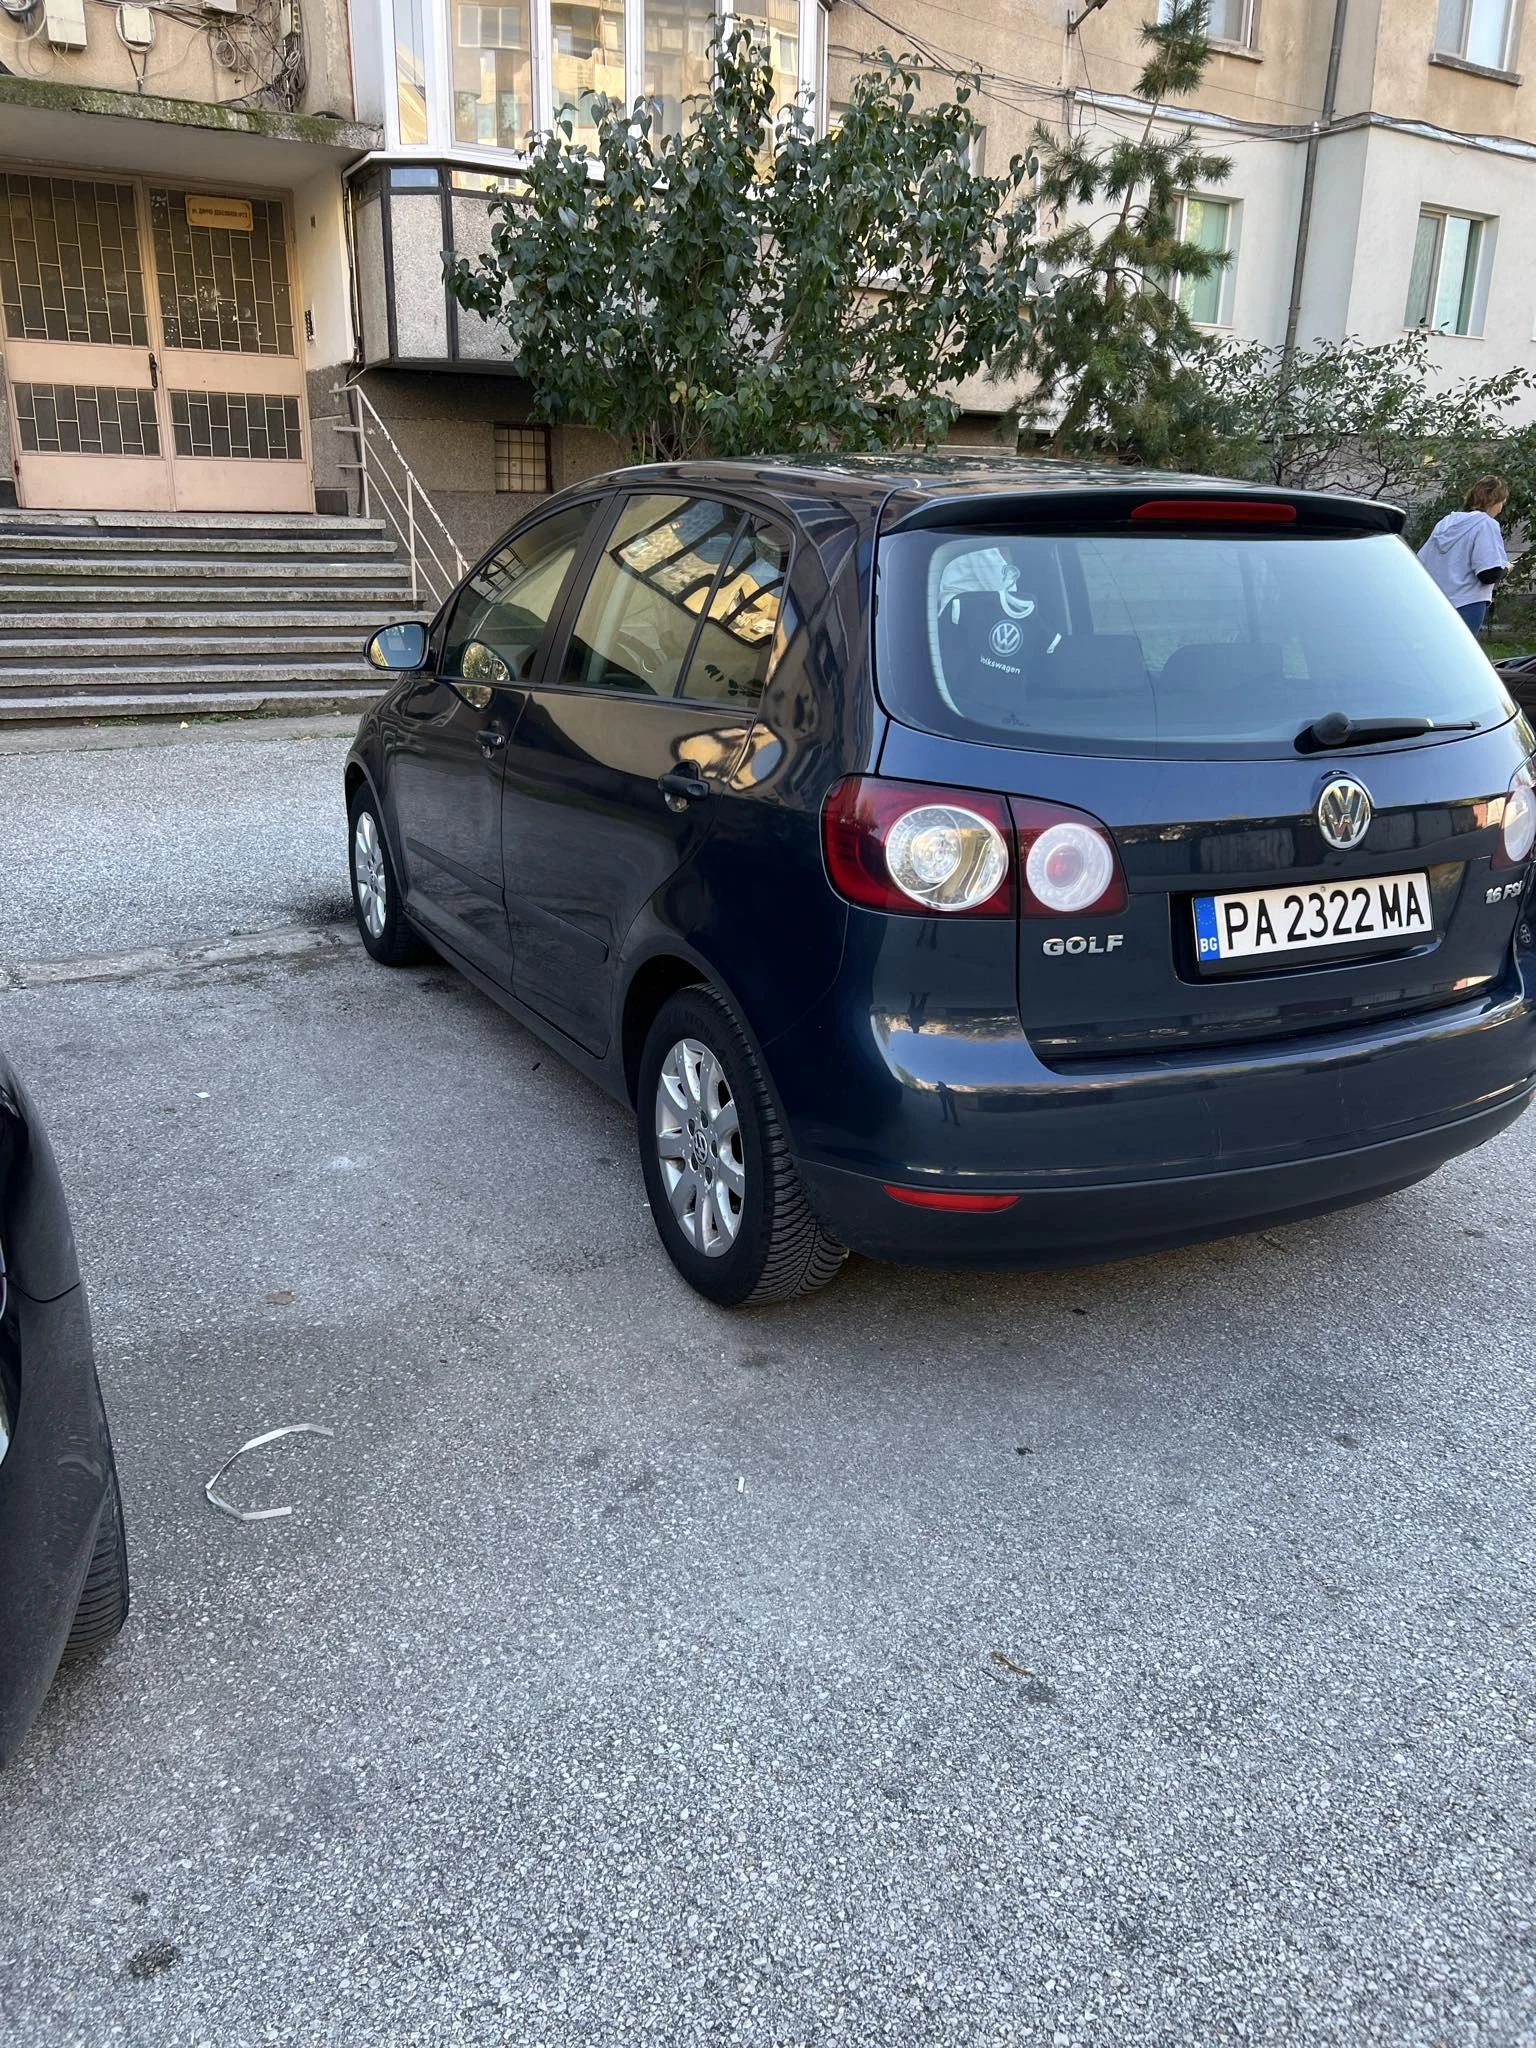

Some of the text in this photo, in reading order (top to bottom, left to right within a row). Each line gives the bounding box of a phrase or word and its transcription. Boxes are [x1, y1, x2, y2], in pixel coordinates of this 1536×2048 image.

[1319, 780, 1370, 848] VW
[1223, 881, 1425, 950] PA 2322 MA
[1043, 935, 1124, 956] GOLF
[1199, 936, 1218, 953] BG
